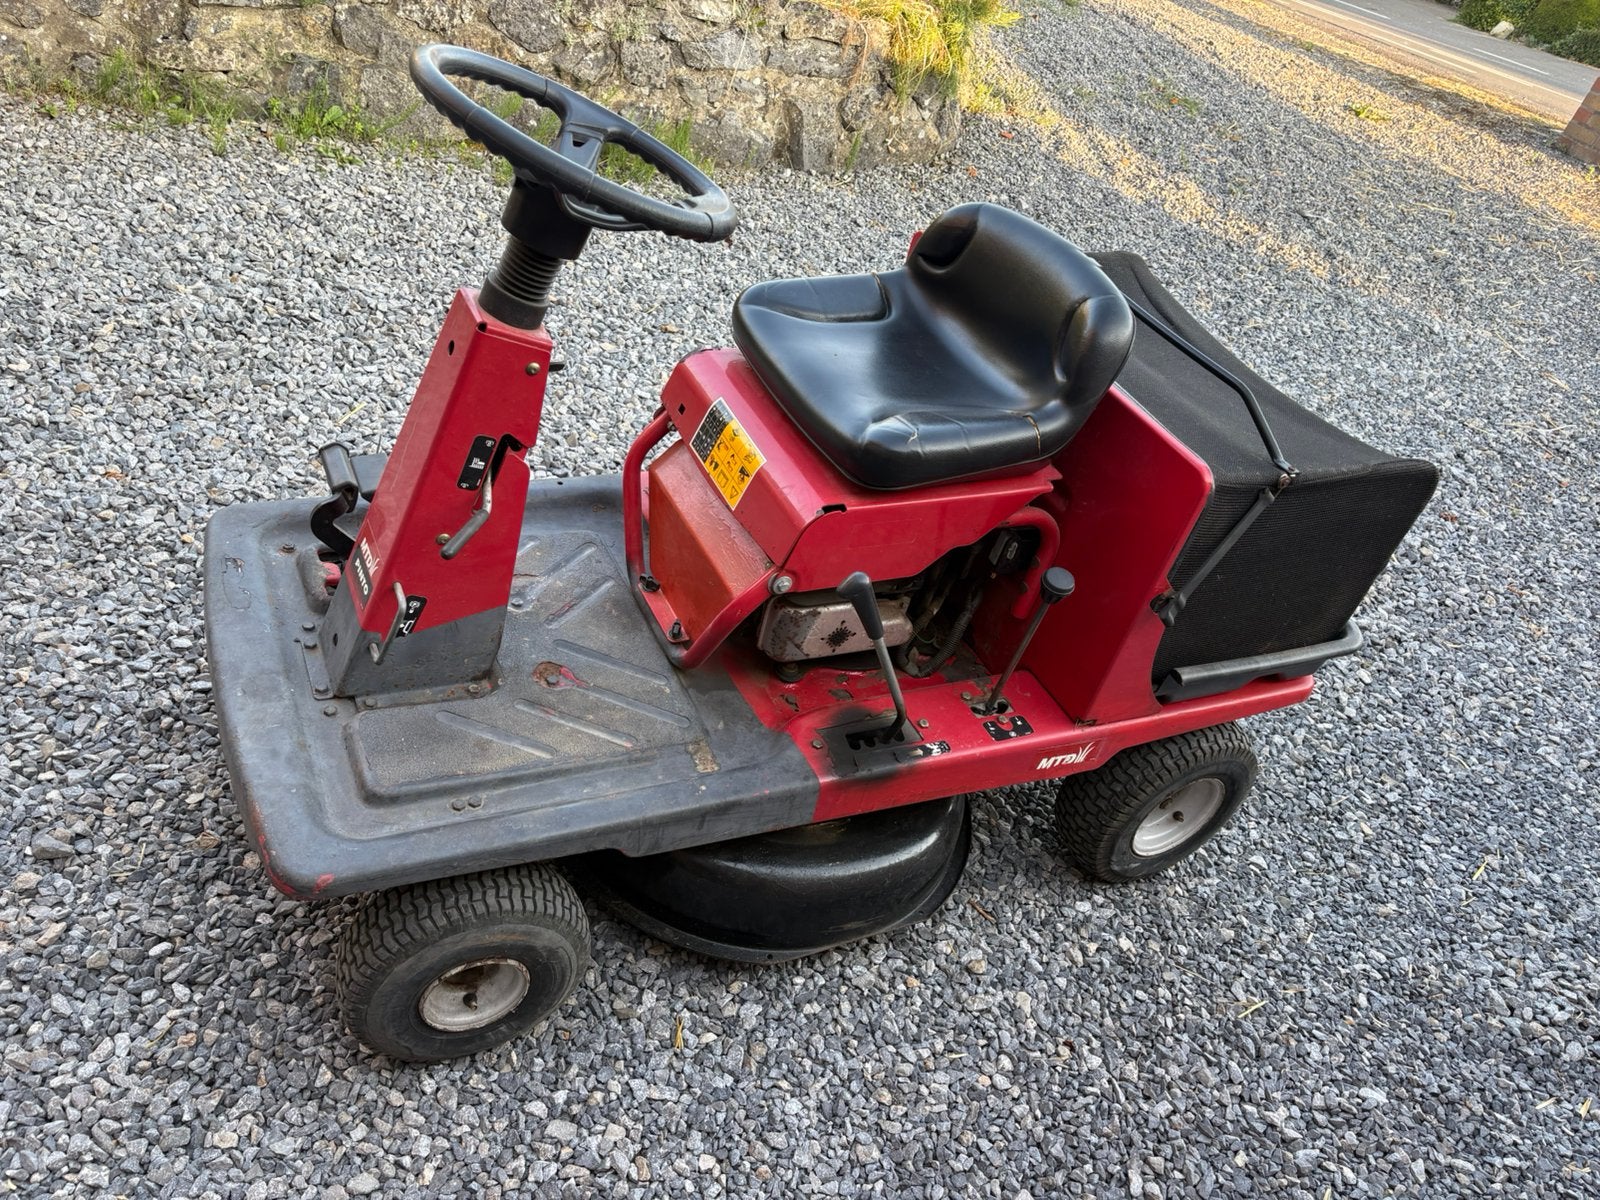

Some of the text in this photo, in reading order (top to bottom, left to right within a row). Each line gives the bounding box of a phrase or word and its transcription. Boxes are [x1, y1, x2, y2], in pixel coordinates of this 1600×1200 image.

[360, 537, 373, 569] MTD
[355, 557, 369, 595] PINTO
[1036, 753, 1077, 770] MTD
